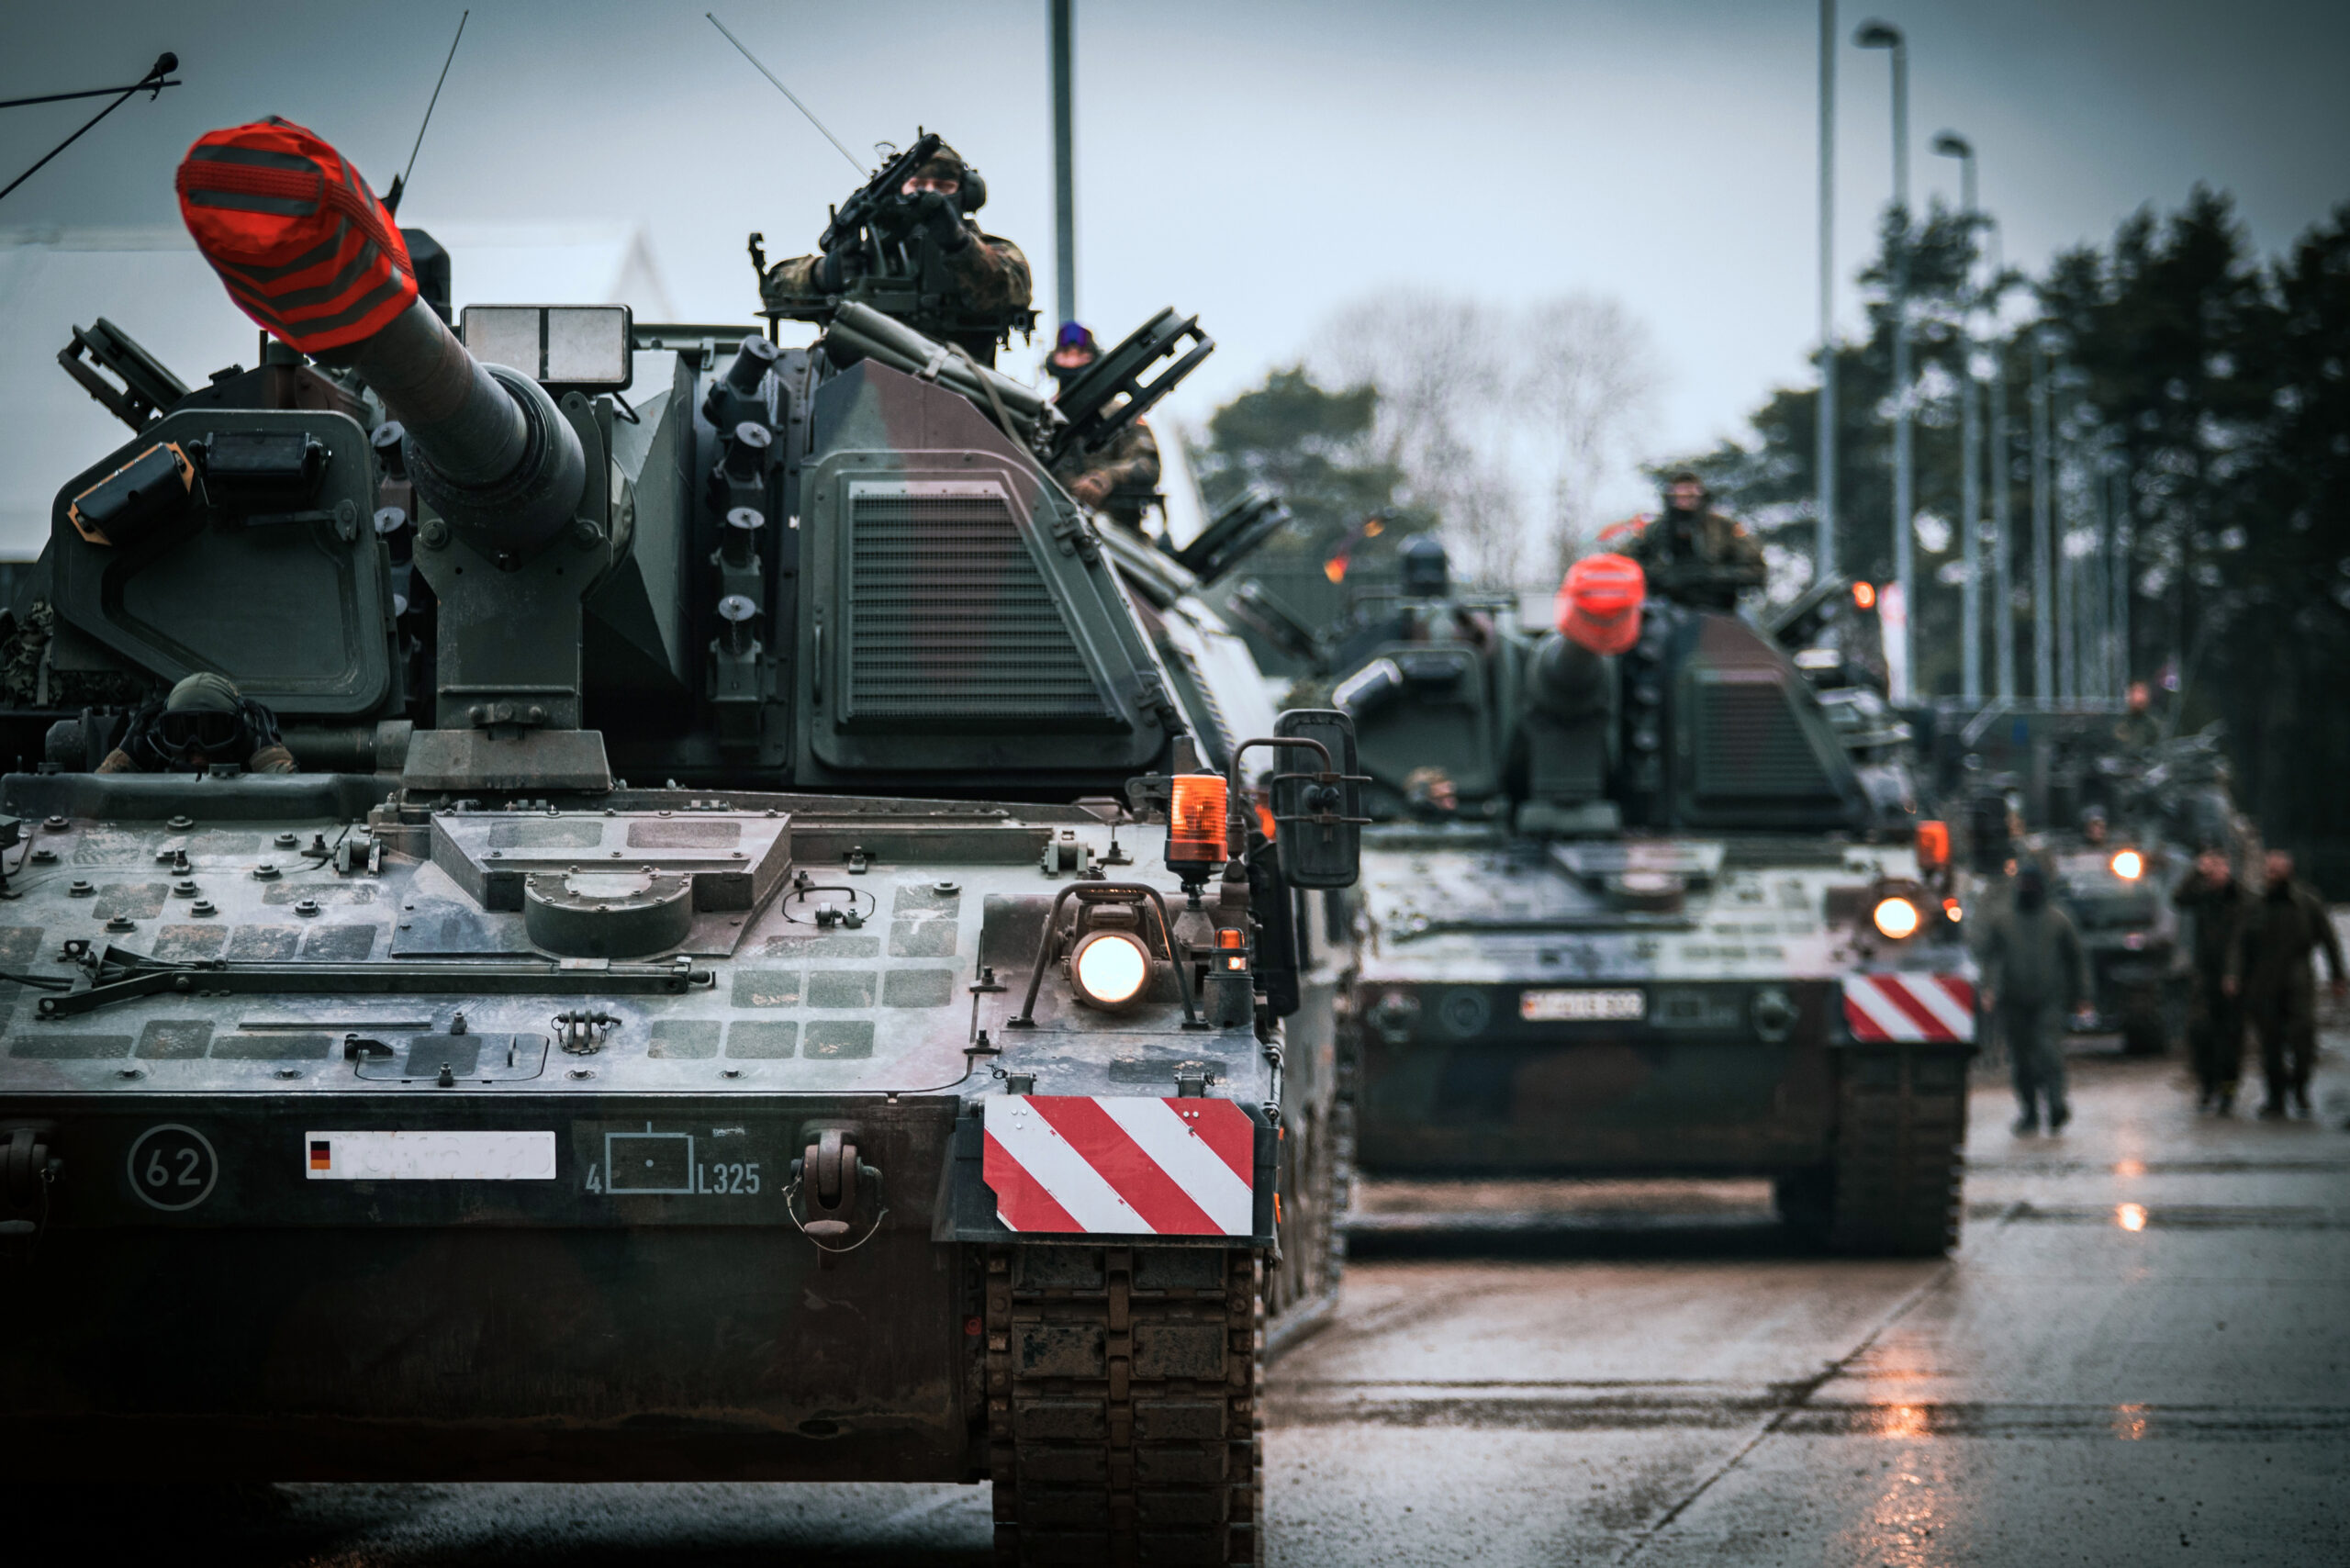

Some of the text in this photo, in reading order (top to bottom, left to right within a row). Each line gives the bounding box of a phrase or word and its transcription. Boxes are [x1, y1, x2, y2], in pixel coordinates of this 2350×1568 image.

[147, 1148, 201, 1187] 62
[586, 1163, 760, 1193] 4 L325
